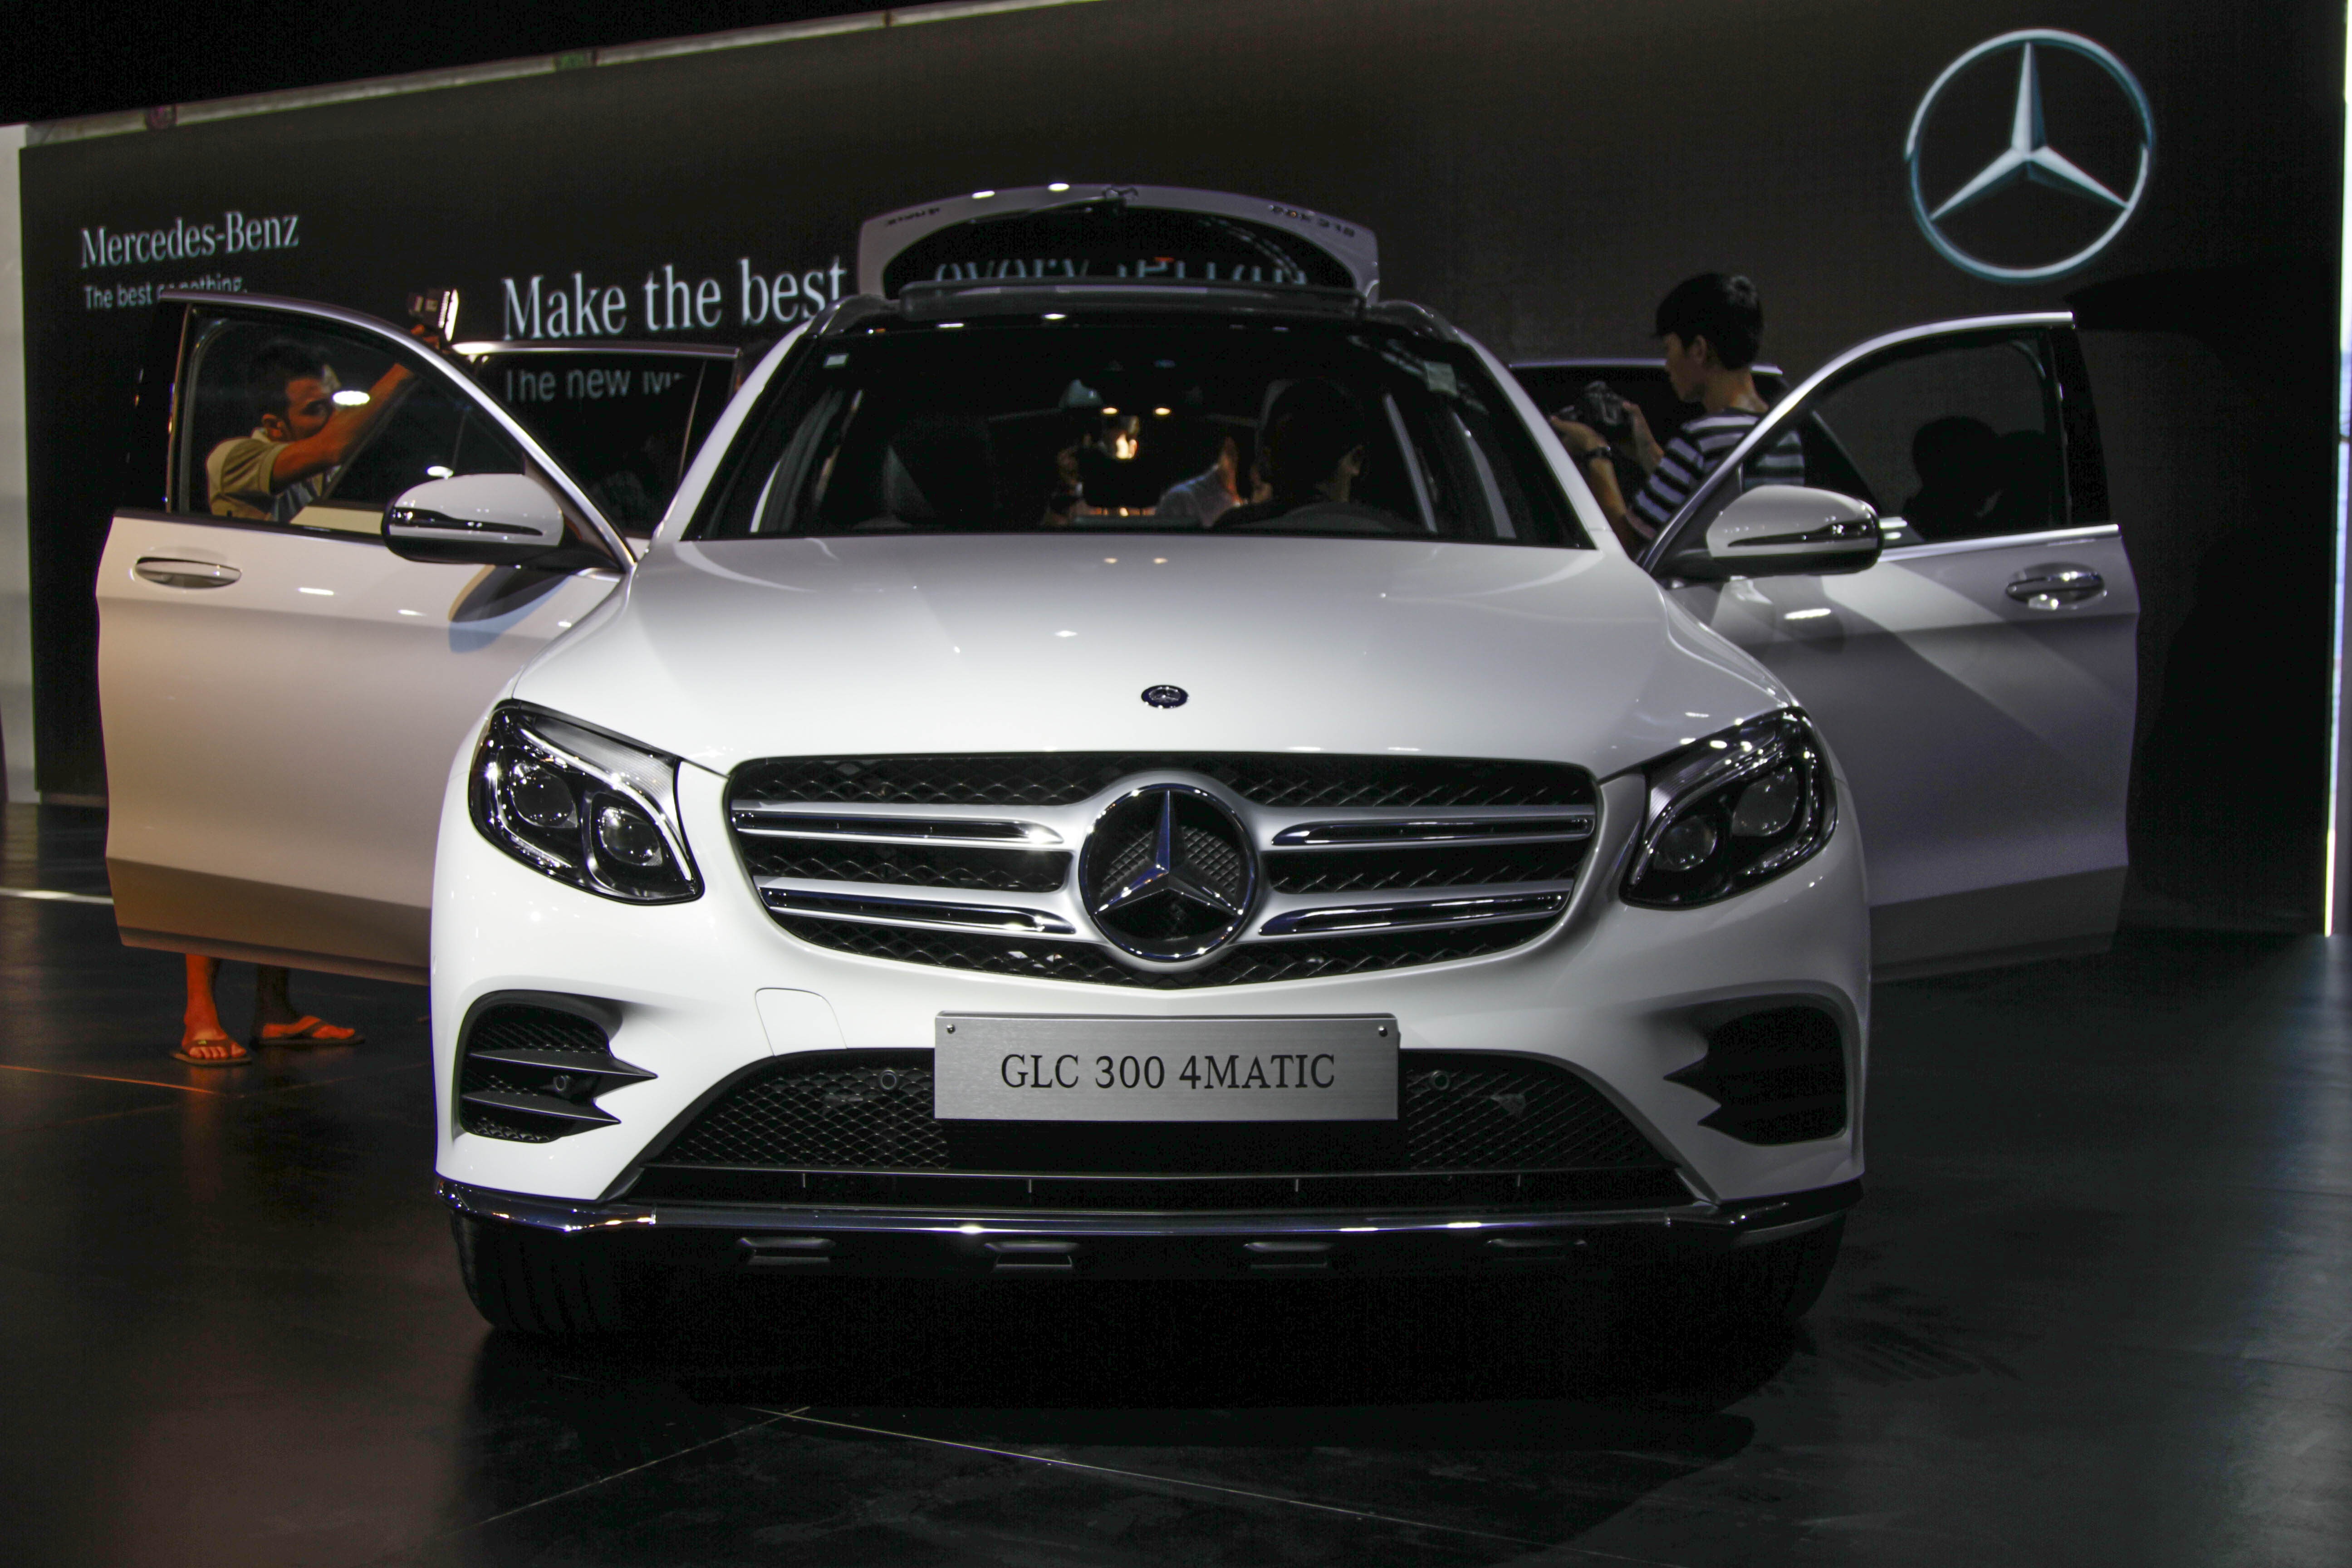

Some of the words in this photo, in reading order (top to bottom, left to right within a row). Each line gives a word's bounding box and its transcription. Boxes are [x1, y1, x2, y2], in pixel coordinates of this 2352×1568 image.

[80, 210, 299, 269] Mercedes-Benz
[84, 284, 113, 309] The
[118, 280, 153, 307] best
[501, 271, 627, 341] Make
[643, 263, 722, 333] the
[737, 256, 848, 325] best
[567, 368, 632, 399] new
[1001, 1054, 1079, 1088] GLC
[1095, 1055, 1165, 1089] 300
[1179, 1054, 1335, 1090] 4MATIC
